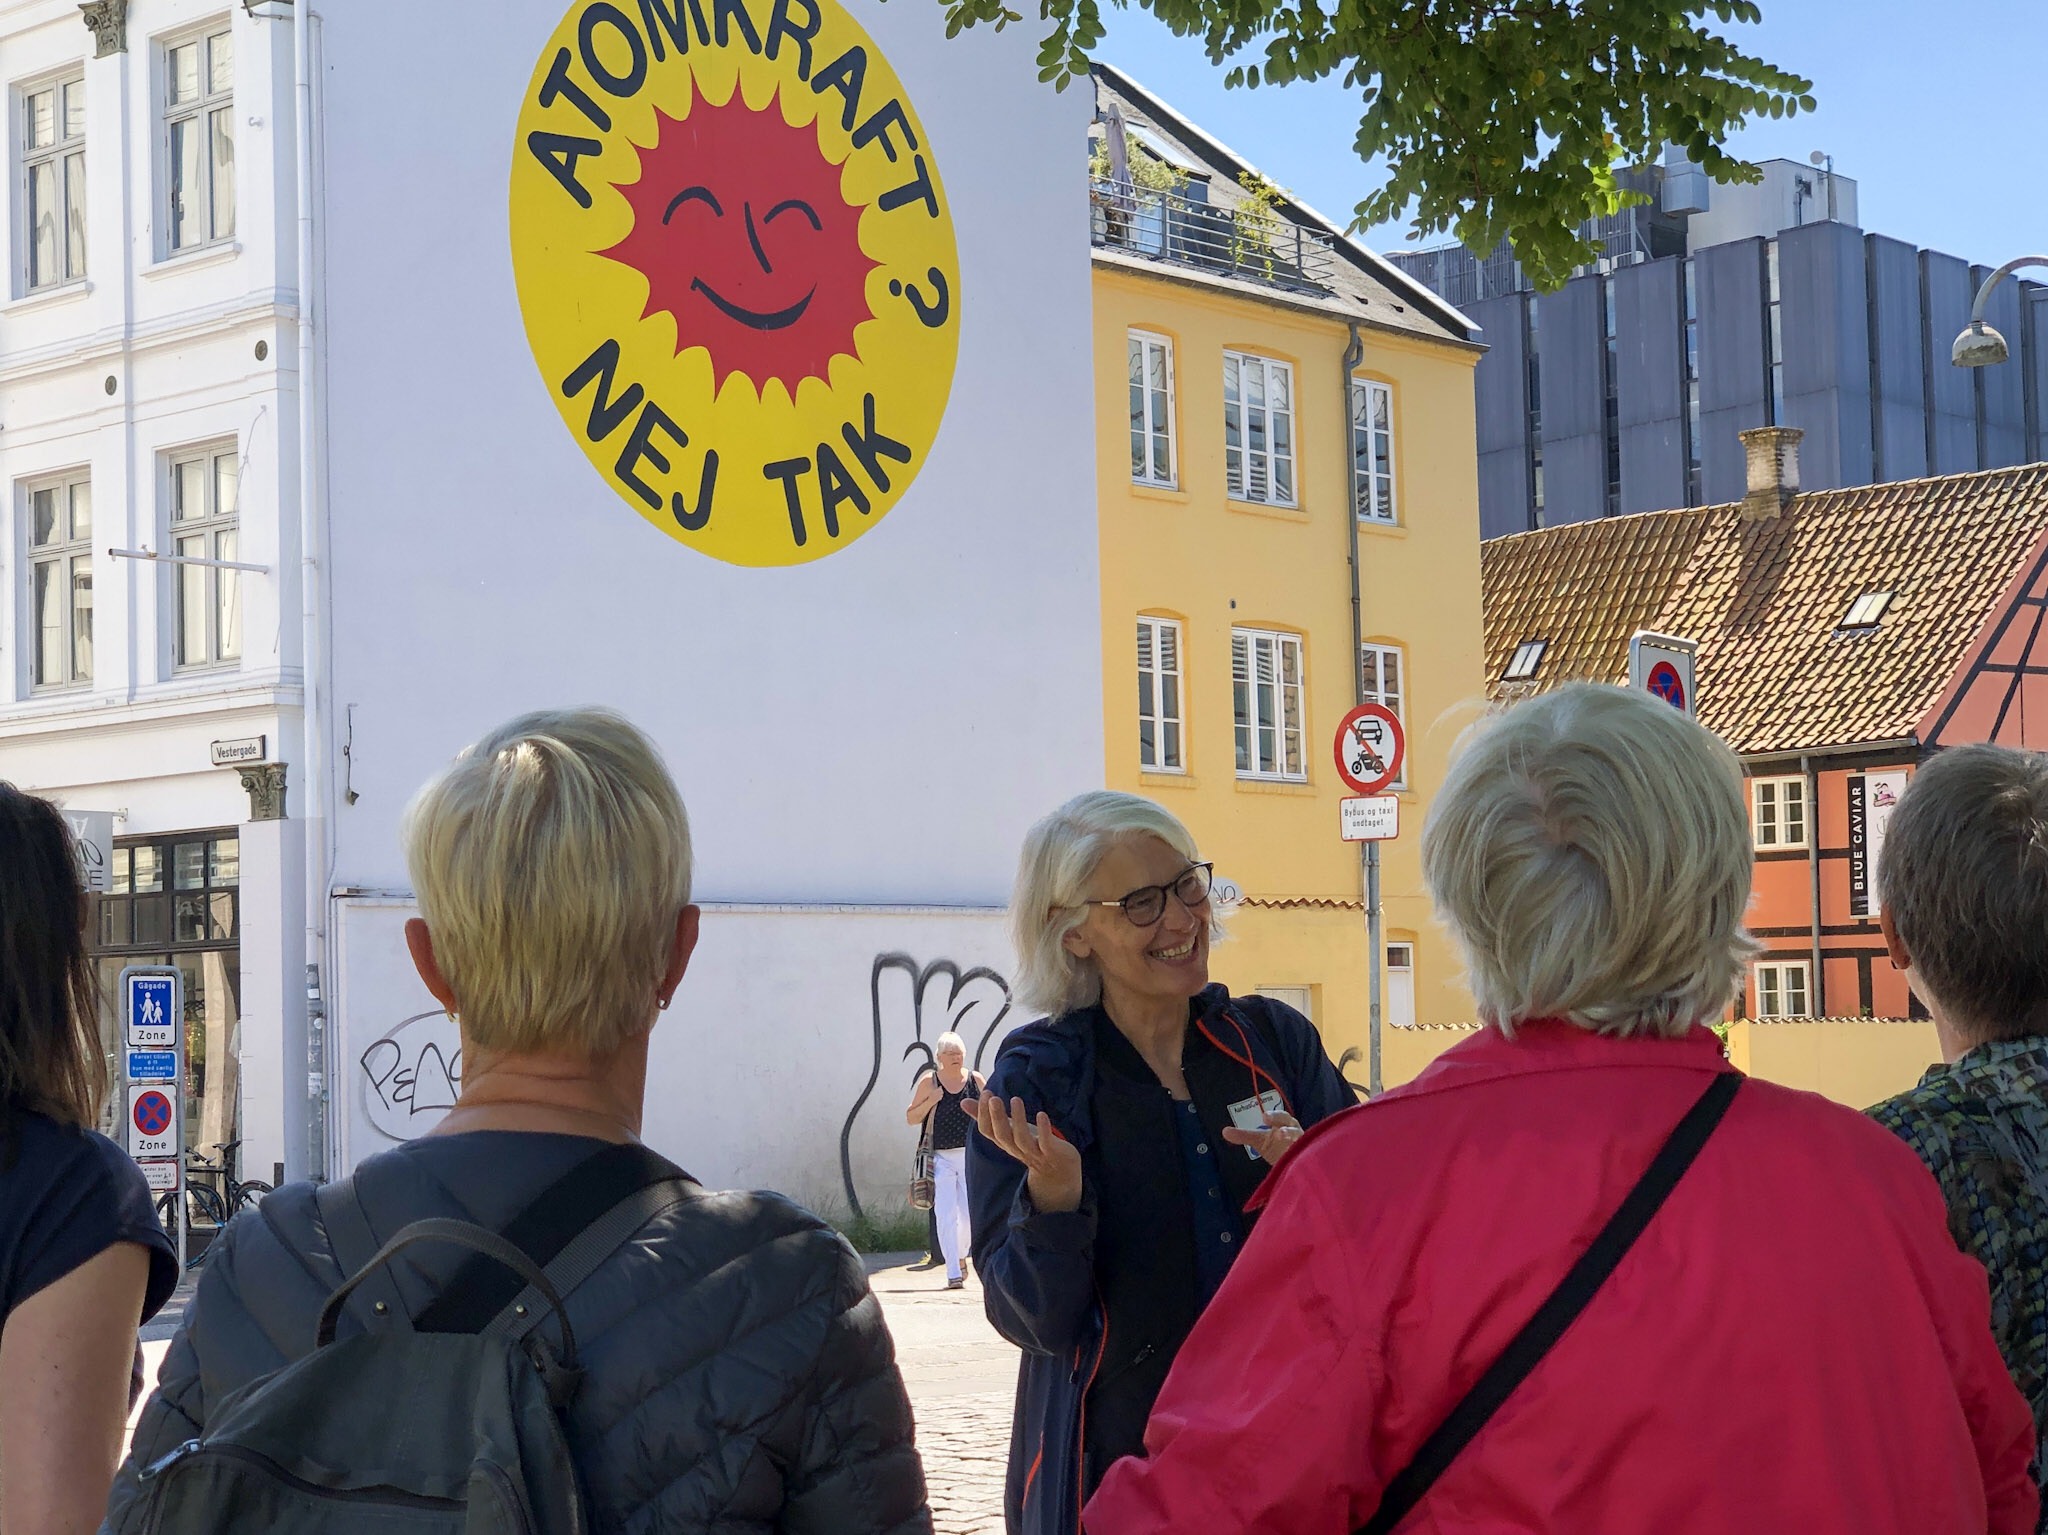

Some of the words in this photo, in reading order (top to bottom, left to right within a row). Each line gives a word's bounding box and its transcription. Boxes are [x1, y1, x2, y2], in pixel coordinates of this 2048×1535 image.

[528, 0, 939, 218] ATOMKRAFT
[561, 338, 719, 531] NEJ
[763, 393, 911, 547] TAK
[216, 744, 257, 759] Vestergade
[1344, 807, 1365, 817] Bybus
[1378, 806, 1394, 815] taxi
[1852, 787, 1863, 844] CAVIAR
[1352, 818, 1384, 827] undtaget
[1853, 851, 1864, 890] BLUE
[138, 982, 166, 990] Gågade
[138, 1030, 166, 1040] Zone
[139, 1140, 167, 1150] Zone
